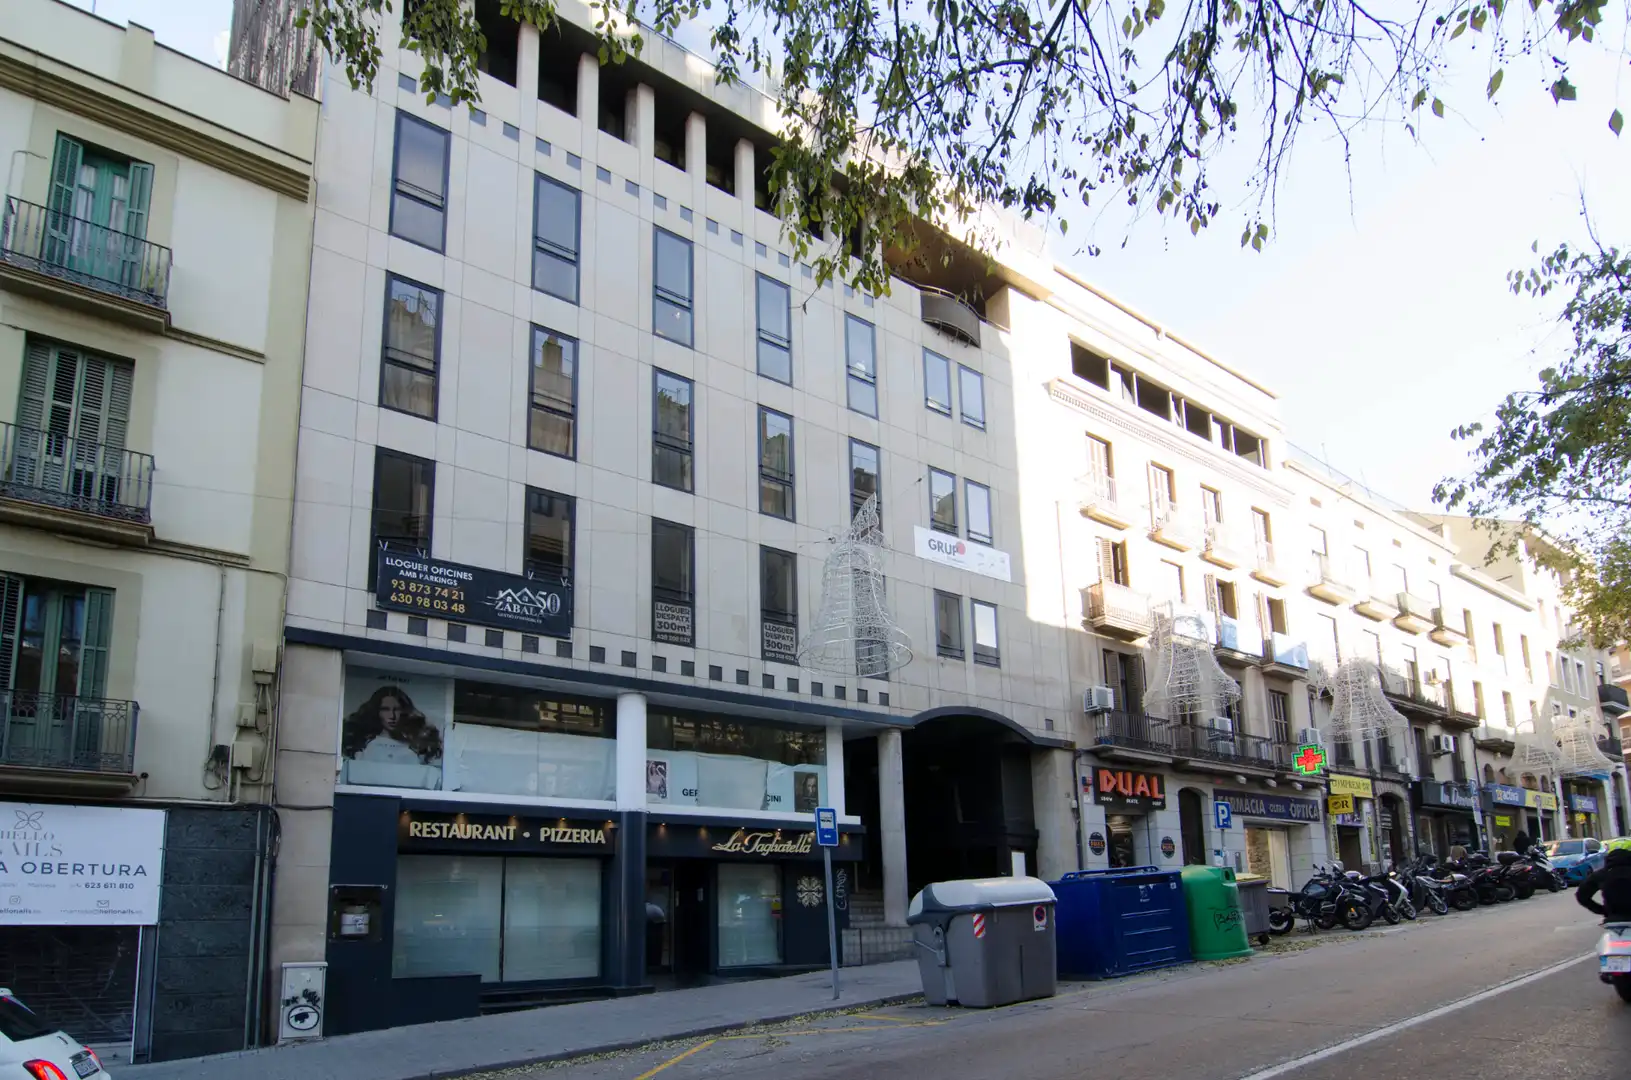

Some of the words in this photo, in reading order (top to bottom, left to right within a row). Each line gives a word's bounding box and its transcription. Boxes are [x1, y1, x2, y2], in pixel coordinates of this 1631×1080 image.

[386, 557, 428, 572] LLOGUER
[431, 566, 473, 580] OFICINES
[399, 569, 417, 579] AMB
[419, 573, 458, 586] PARKINGS
[391, 579, 405, 591] 93
[409, 582, 431, 595] 873
[434, 586, 448, 598] 74
[451, 590, 464, 601] 21
[390, 592, 413, 605] 630
[416, 596, 430, 608] 98
[434, 600, 448, 611] 03
[451, 602, 465, 613] 48
[656, 602, 691, 615] LLOGUER
[656, 612, 690, 623] DESPATX
[765, 624, 795, 635] LLOGUER
[765, 632, 794, 642] DESPATX
[1098, 769, 1165, 799] DUAL
[1217, 804, 1228, 825] P
[409, 821, 517, 841] RESTAURANT
[539, 826, 606, 845] PIZZERIA
[712, 831, 742, 853] La
[21, 861, 148, 877] OBERTURA
[84, 882, 102, 890] 623
[103, 882, 117, 890] 611
